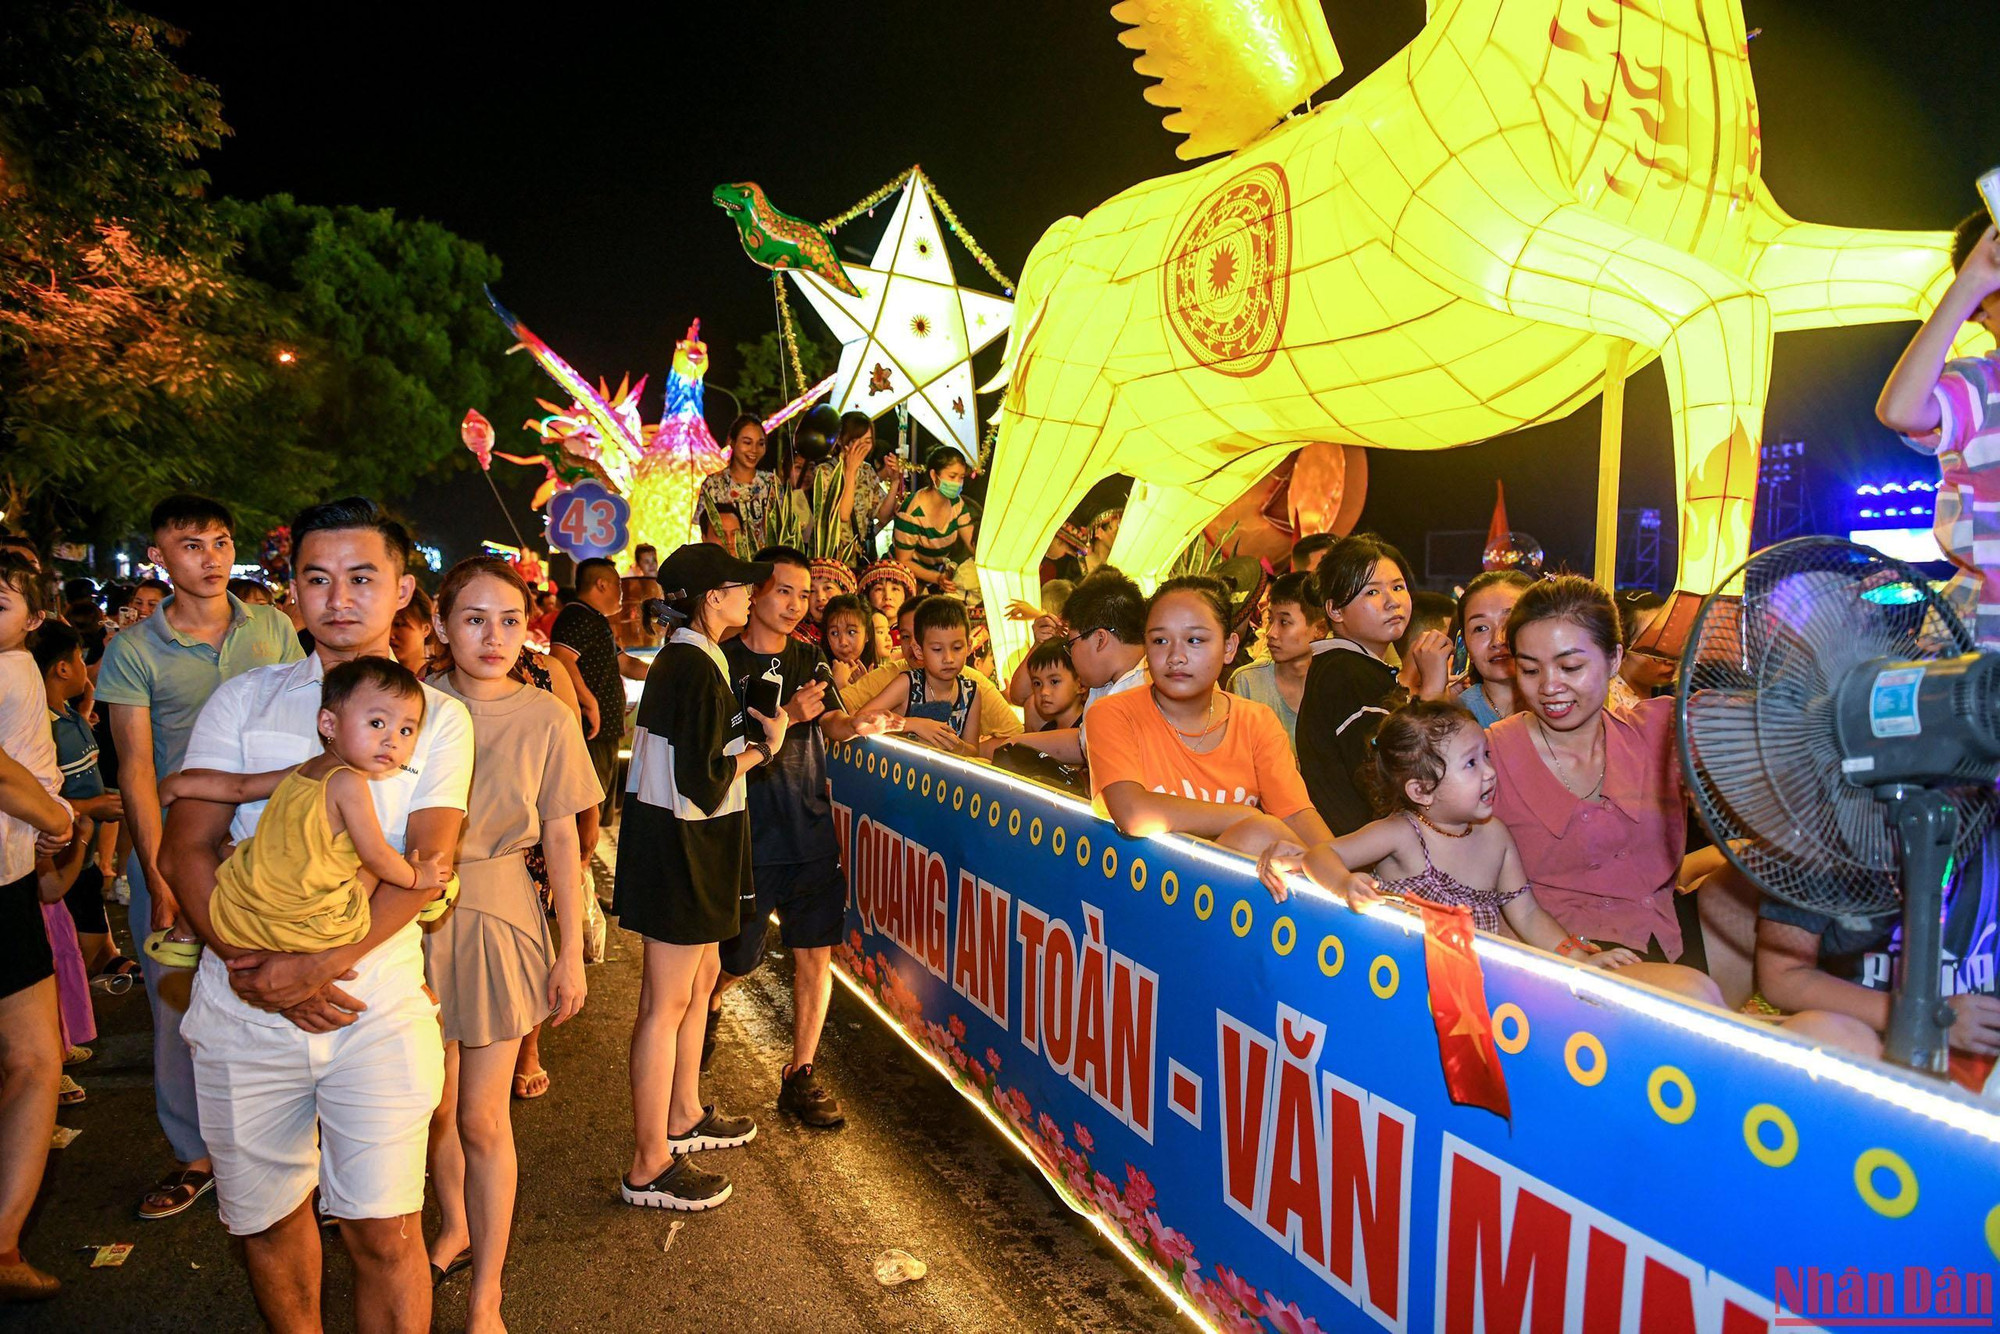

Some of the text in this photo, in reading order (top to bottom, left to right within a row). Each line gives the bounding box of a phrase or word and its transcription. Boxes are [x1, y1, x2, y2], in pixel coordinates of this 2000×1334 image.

[559, 498, 617, 547] 43
[856, 813, 948, 984] QUANG
[952, 867, 1011, 1032] AN
[1016, 899, 1159, 1146] TOÀN
[1216, 1000, 1416, 1334] VĂN
